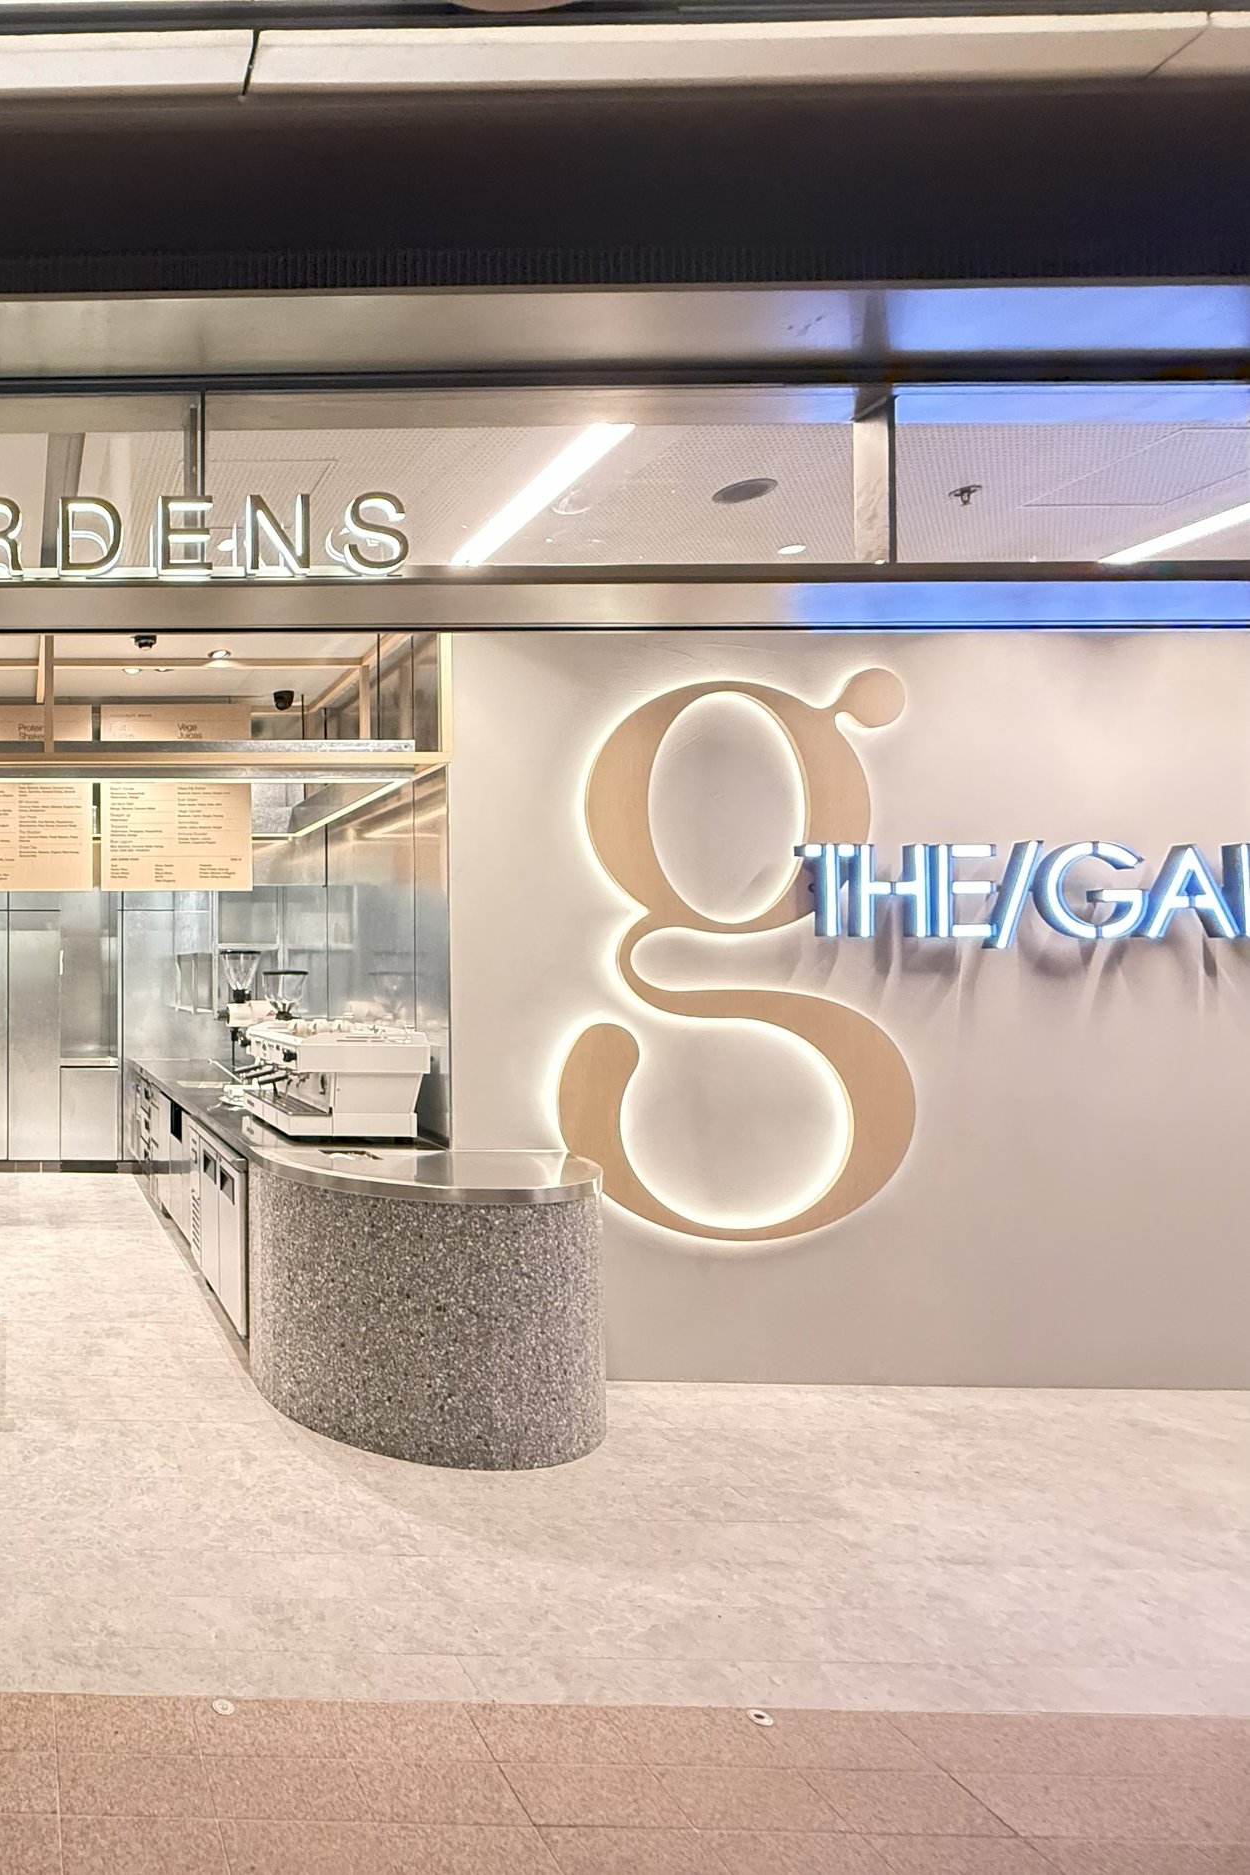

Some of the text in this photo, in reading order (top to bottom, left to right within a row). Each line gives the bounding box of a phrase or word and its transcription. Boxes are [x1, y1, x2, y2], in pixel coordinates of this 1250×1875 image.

[177, 723, 198, 733] Vege
[793, 840, 1250, 949] THE/GA
[558, 667, 917, 1241] g
